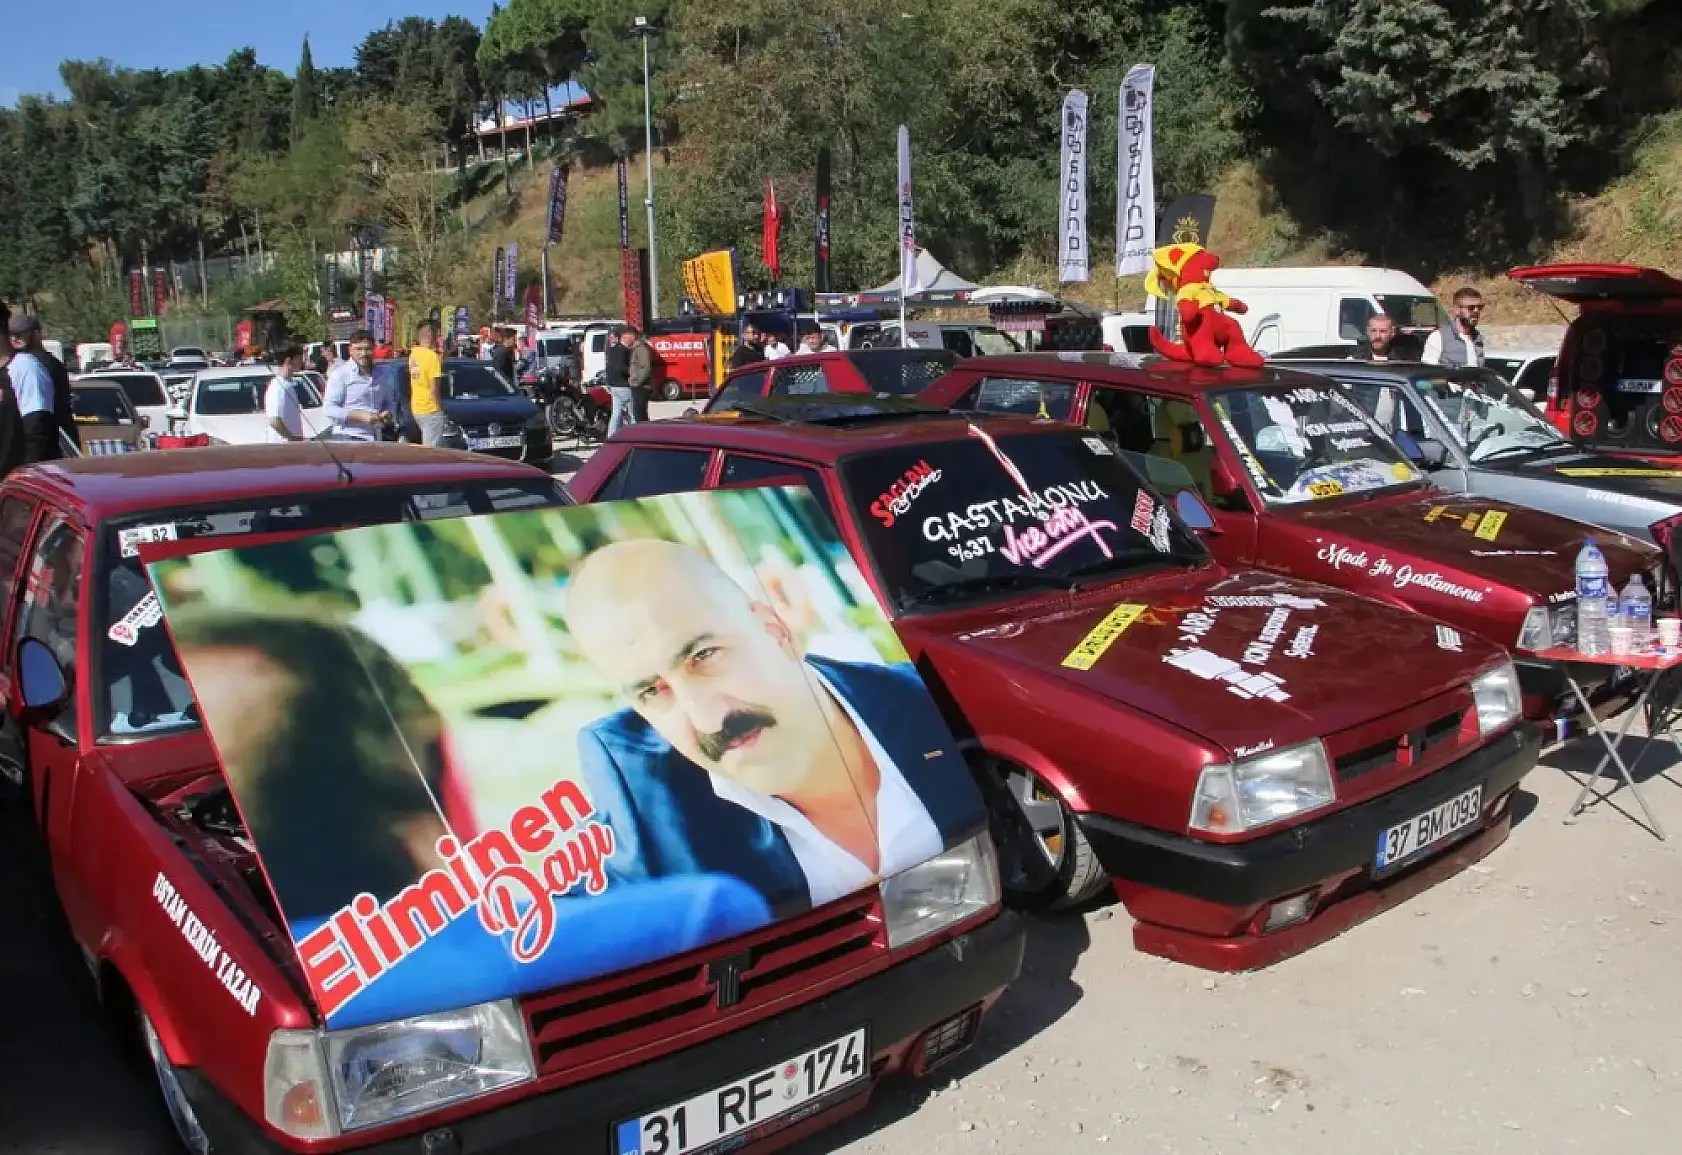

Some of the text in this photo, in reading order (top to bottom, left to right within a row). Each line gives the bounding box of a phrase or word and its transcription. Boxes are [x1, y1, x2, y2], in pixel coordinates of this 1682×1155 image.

[922, 480, 1109, 541] GASTAMONU
[1387, 789, 1479, 860] 37 BM 093
[297, 779, 594, 1019] Eliminen
[643, 1105, 687, 1155] 31
[717, 1071, 776, 1133] RF
[803, 1036, 862, 1096] 174
